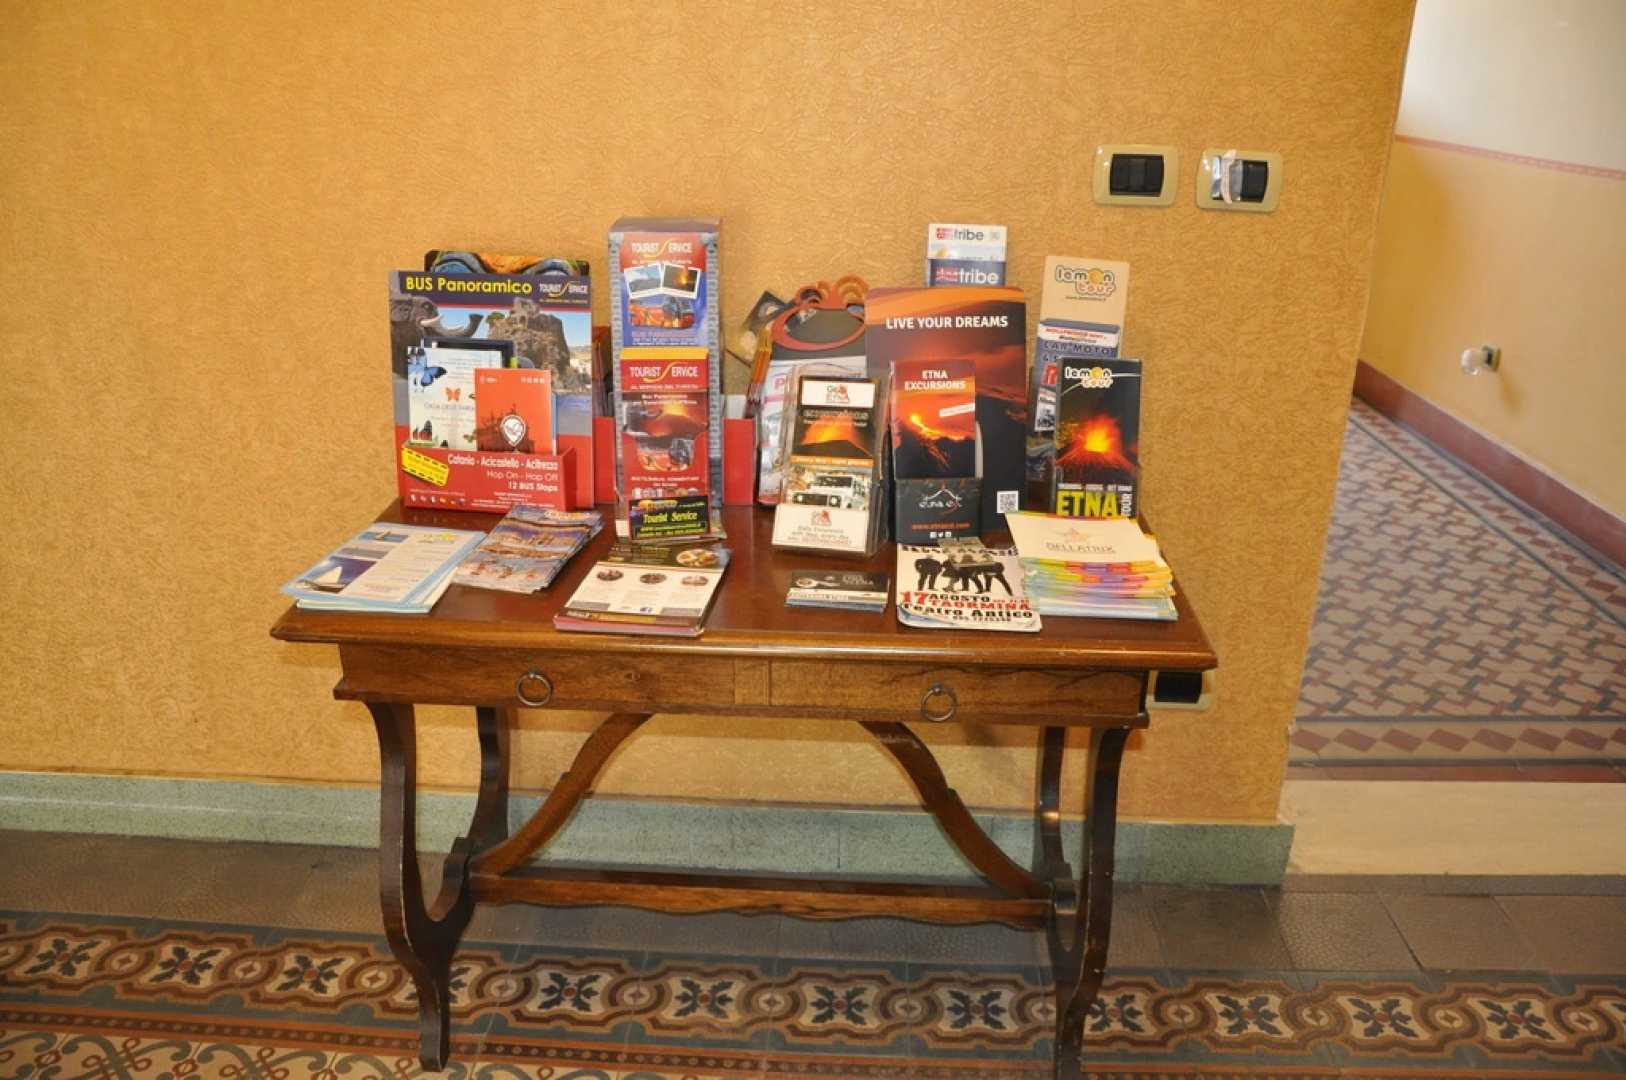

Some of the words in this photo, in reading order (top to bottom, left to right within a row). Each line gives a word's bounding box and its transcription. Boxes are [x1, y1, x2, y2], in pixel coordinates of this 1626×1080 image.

[954, 228, 984, 241] tribe
[632, 242, 660, 253] TOURIST
[959, 267, 999, 284] tribe
[1056, 266, 1113, 284] lemon
[405, 275, 434, 292] BUS
[438, 277, 533, 295] Panoramico
[1077, 282, 1114, 294] tour
[886, 317, 915, 329] LIVE
[917, 316, 952, 329] YOUR
[955, 315, 1009, 328] DREAMS
[1044, 341, 1067, 350] CAR
[1073, 343, 1109, 355] MOTO
[629, 366, 661, 378] TOURIST
[922, 369, 948, 379] ETNA
[1065, 367, 1112, 379] lemon
[904, 380, 966, 391] EXCURSIONS
[1082, 379, 1113, 388] tour
[447, 453, 475, 466] Catania
[481, 456, 519, 469] Acicastello
[487, 470, 504, 480] Hop
[506, 470, 518, 479] On
[525, 472, 543, 482] Hop
[545, 472, 558, 481] Off
[508, 481, 517, 490] 12
[519, 482, 534, 490] BUS
[536, 483, 558, 493] Stops
[1056, 490, 1119, 517] ETNA
[643, 512, 668, 524] Tourist
[671, 510, 698, 522] Service
[900, 590, 930, 604] 17
[929, 593, 991, 603] AGOSTO
[902, 603, 963, 616] Teatro
[971, 608, 1034, 619] Antico
[931, 599, 1031, 611] TAORMINA
